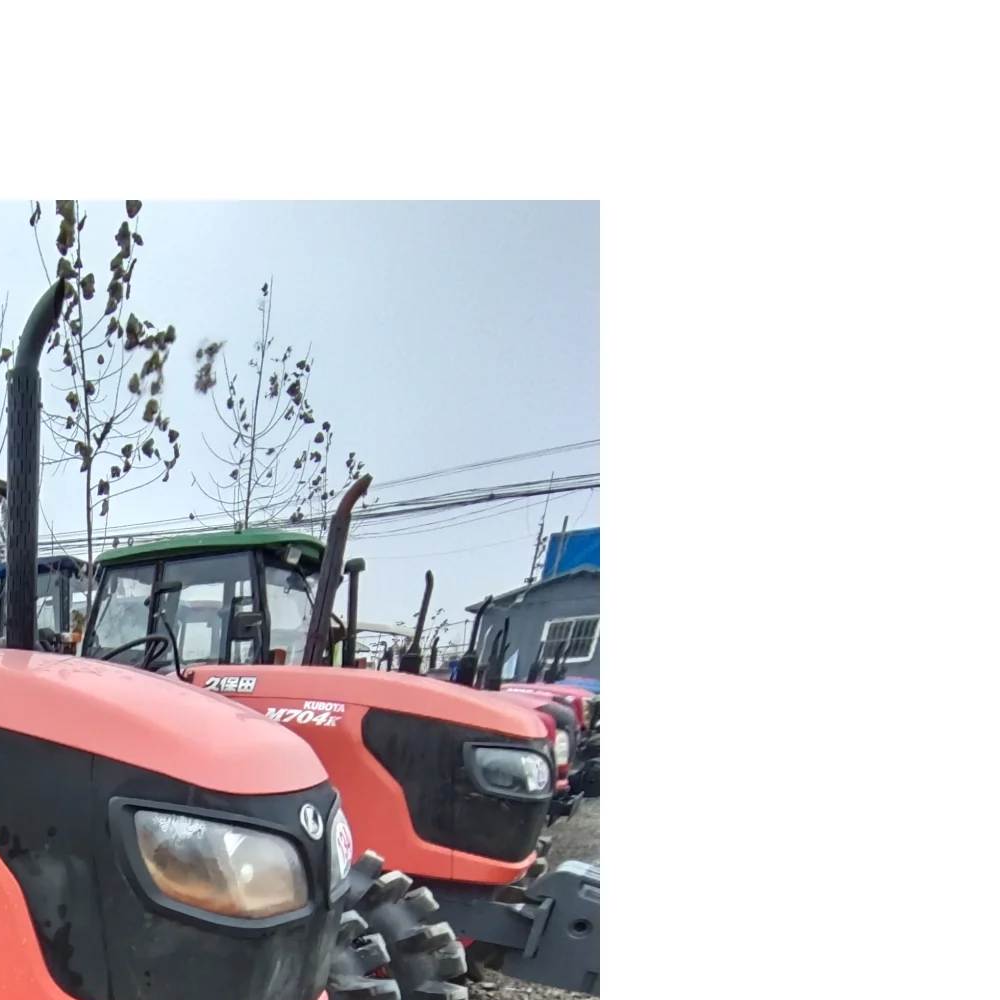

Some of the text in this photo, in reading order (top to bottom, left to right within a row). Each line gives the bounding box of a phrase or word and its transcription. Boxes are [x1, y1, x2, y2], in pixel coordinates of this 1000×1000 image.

[204, 676, 256, 693] 久保田
[303, 701, 345, 713] KUBOTA
[264, 707, 342, 727] M704K
